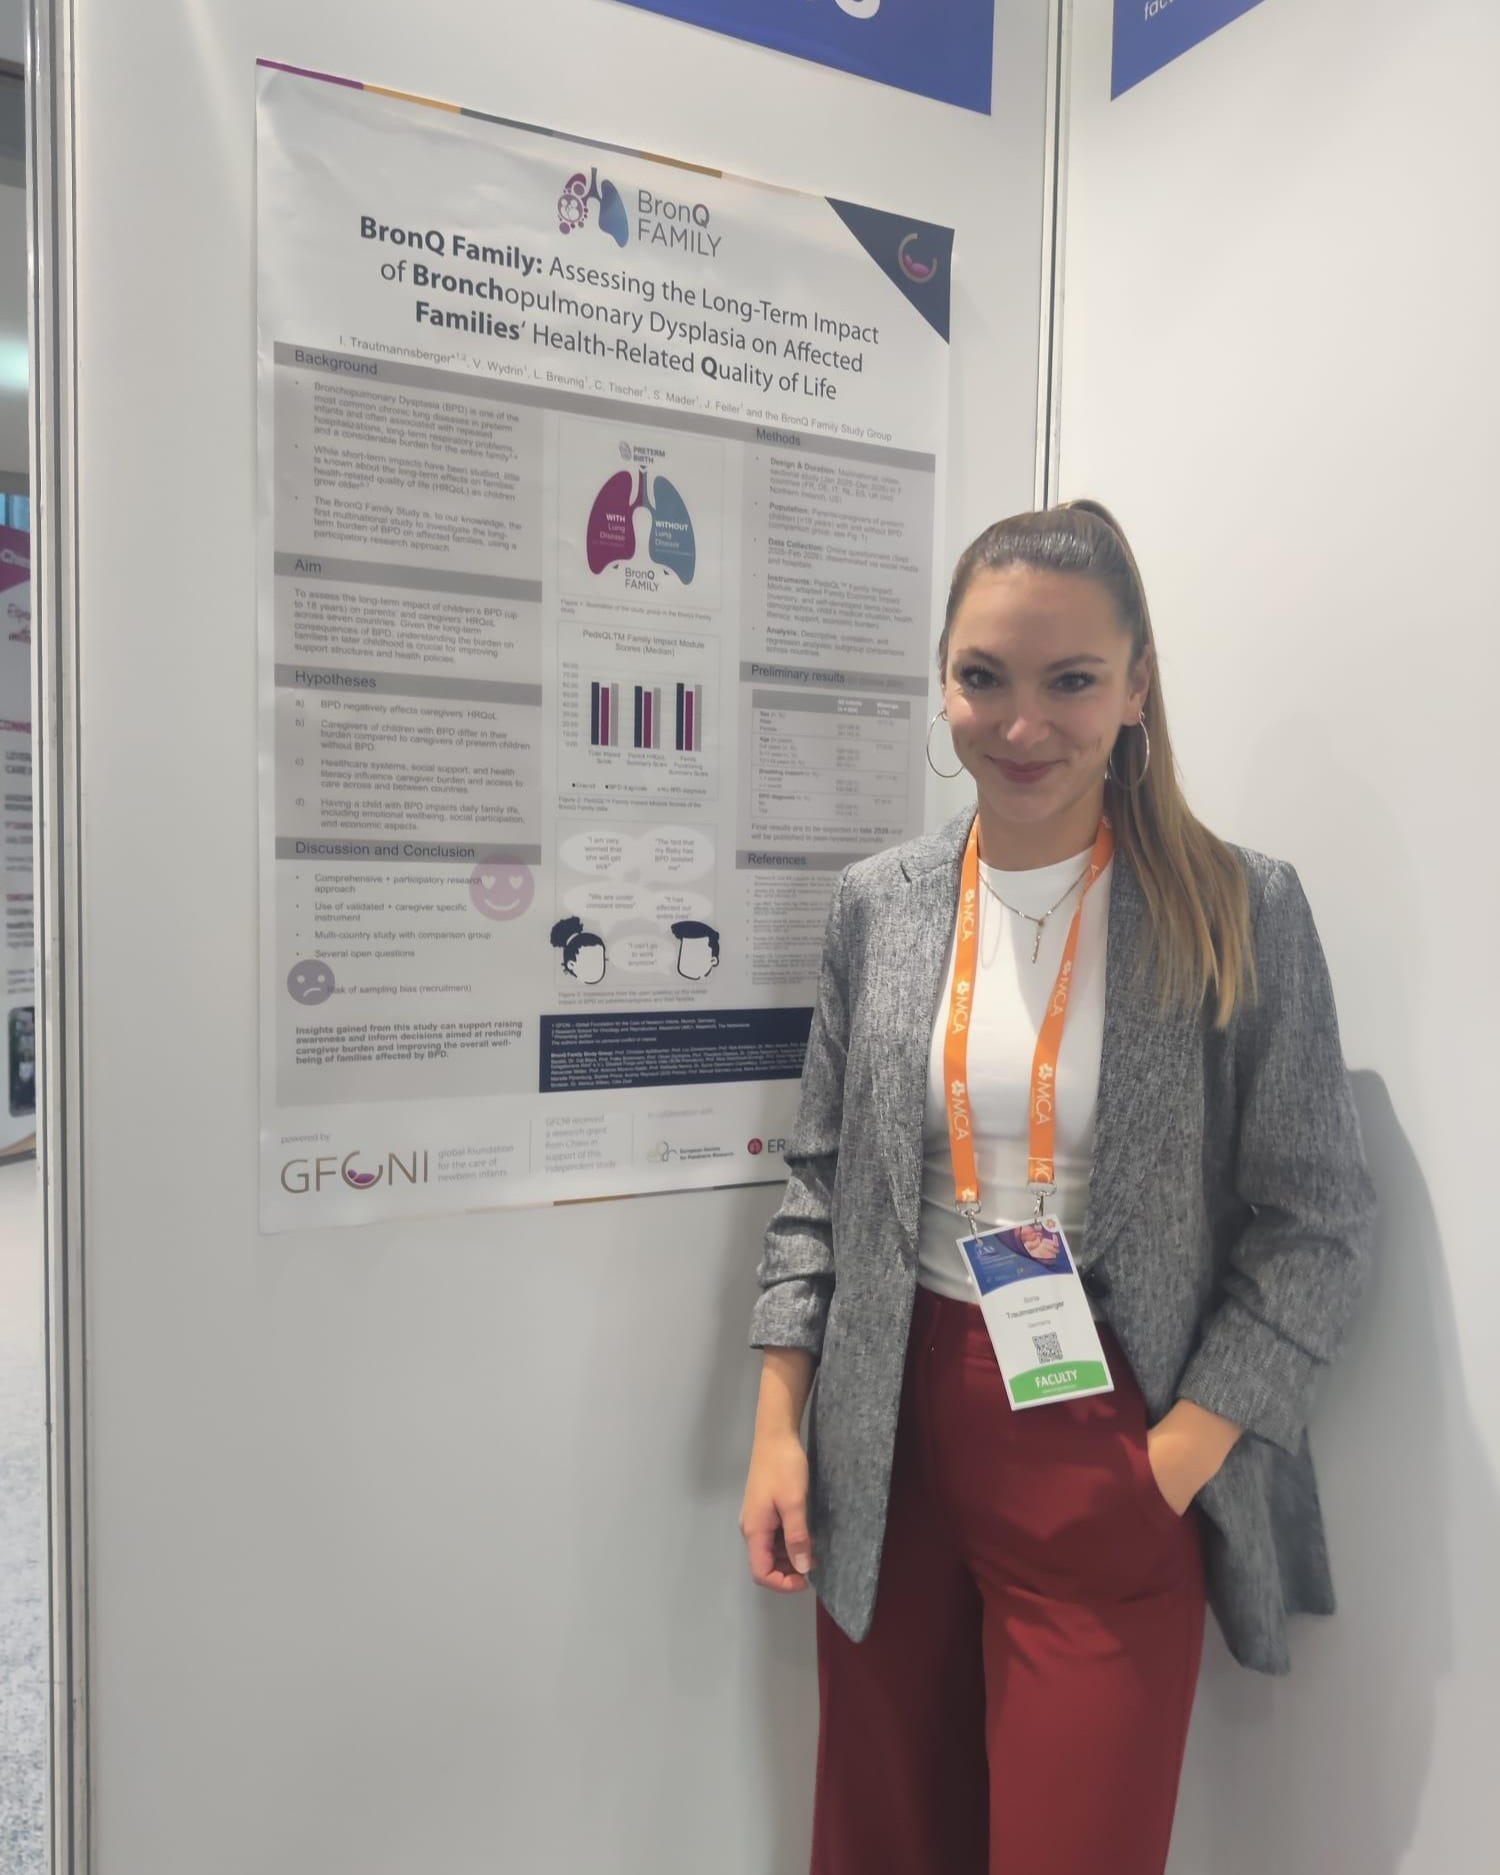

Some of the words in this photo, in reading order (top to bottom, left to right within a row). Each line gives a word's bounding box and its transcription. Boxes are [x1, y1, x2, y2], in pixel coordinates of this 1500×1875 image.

[638, 189, 710, 229] BronQ
[638, 218, 722, 258] FAMILY
[360, 217, 444, 257] BronQ
[452, 236, 542, 279] Family:
[549, 257, 654, 303] Assessing
[662, 280, 695, 306] the
[702, 289, 807, 329] Long-Term
[814, 312, 879, 344] Impact
[380, 259, 407, 284] of
[413, 262, 642, 336] Bronchopulmonary
[650, 310, 745, 350] Dysplasia
[752, 336, 777, 356] on
[784, 337, 862, 372] Affected
[295, 350, 377, 376] Background
[533, 323, 694, 373] Health-Related
[701, 355, 773, 393] Quality
[779, 372, 799, 393] of
[804, 374, 836, 400] Life
[746, 410, 764, 419] and
[766, 411, 778, 421] the
[781, 414, 808, 427] BronQ
[811, 419, 838, 434] Family
[841, 424, 864, 438] Study
[867, 429, 892, 443] Group
[756, 427, 801, 446] Methods
[606, 513, 626, 523] WITH
[655, 520, 689, 532] WITHOUT
[768, 538, 784, 548] Data
[294, 558, 322, 574] Aim
[624, 567, 655, 580] BronQ
[624, 578, 660, 592] FAMILY
[295, 589, 306, 599] To
[309, 593, 339, 602] assess
[343, 594, 356, 603] the
[402, 600, 429, 611] impact
[433, 604, 440, 612] of
[484, 609, 502, 618] BPD
[627, 634, 651, 645] Family
[654, 636, 678, 648] Impact
[679, 639, 705, 650] Module
[616, 644, 641, 654] Scores
[642, 646, 675, 657] (Median)
[295, 670, 377, 690] Hypotheses
[751, 664, 808, 682] Preliminary
[811, 672, 844, 684] results
[296, 699, 304, 709] a)
[320, 700, 341, 709] BPD
[344, 703, 386, 714] negatively
[390, 705, 418, 715] affects
[296, 842, 372, 855] Discussion
[374, 844, 398, 856] and
[404, 845, 474, 857] Conclusion
[748, 853, 806, 866] References
[314, 874, 383, 884] Comprehensive
[394, 876, 444, 885] participatory
[314, 885, 356, 894] approach
[346, 903, 384, 911] validated
[394, 904, 434, 913] caregiver
[436, 904, 467, 913] specific
[962, 903, 975, 942] MCA
[315, 931, 370, 940] Multi-country
[374, 931, 396, 940] study
[418, 931, 466, 940] comparison
[374, 950, 415, 959] questions
[360, 986, 398, 995] sampling
[420, 984, 472, 994] (recruitment)
[1051, 977, 1069, 1017] MCA
[952, 996, 968, 1034] MCA
[296, 1026, 334, 1036] Insights
[336, 1025, 366, 1035] gained
[370, 1024, 390, 1032] from
[394, 1023, 410, 1031] this
[414, 1023, 438, 1031] study
[458, 1021, 492, 1030] support
[494, 1020, 522, 1028] raising
[400, 1032, 442, 1040] decisions
[485, 1030, 522, 1038] reducing
[296, 1046, 339, 1055] caregiver
[376, 1043, 394, 1051] and
[396, 1042, 441, 1052] improving
[460, 1040, 488, 1048] overall
[296, 1056, 322, 1065] being
[337, 1054, 372, 1062] families
[375, 1052, 412, 1060] affected
[414, 1051, 424, 1060] by
[428, 1050, 448, 1058] BPD.
[1036, 1080, 1051, 1126] MCA
[952, 1097, 970, 1142] MCA
[280, 1134, 318, 1144] powered
[320, 1132, 331, 1142] by
[767, 1138, 786, 1154] ER
[438, 1149, 465, 1160] global
[466, 1144, 514, 1157] foundation
[438, 1162, 450, 1171] for
[452, 1160, 466, 1170] the
[468, 1161, 487, 1169] care
[488, 1158, 498, 1167] of
[1034, 1159, 1051, 1184] MC
[438, 1171, 477, 1182] newborn
[478, 1168, 508, 1179] infants
[1034, 1369, 1078, 1388] FACULTY
